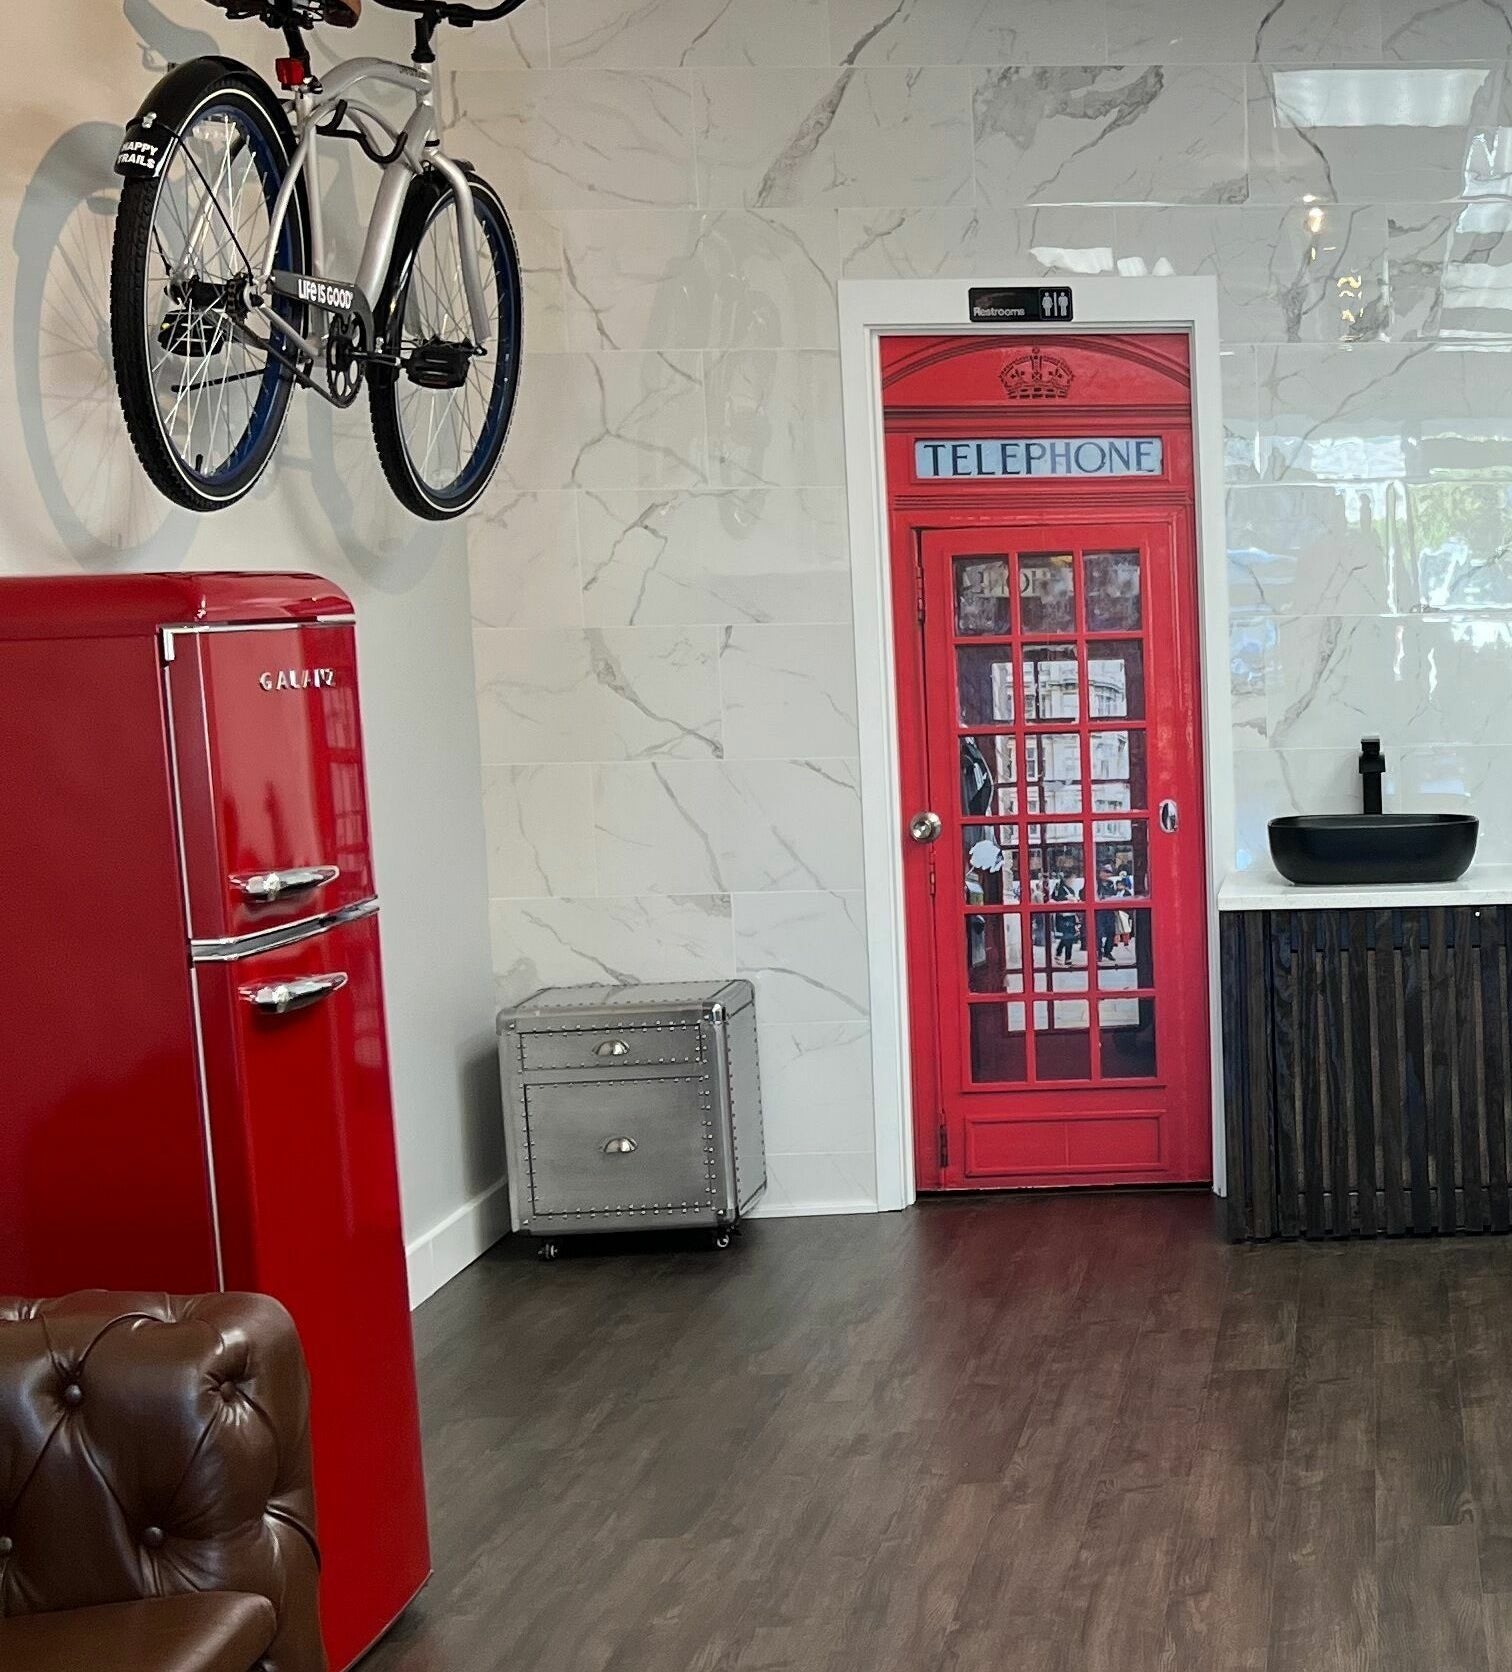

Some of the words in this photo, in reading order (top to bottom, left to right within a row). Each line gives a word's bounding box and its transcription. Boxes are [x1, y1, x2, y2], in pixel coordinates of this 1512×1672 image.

[121, 141, 159, 156] HAPPY
[117, 153, 156, 169] TRAILS
[326, 285, 352, 309] GOOD
[973, 306, 1025, 317] Restrooms
[923, 440, 1155, 477] TELEPHONE
